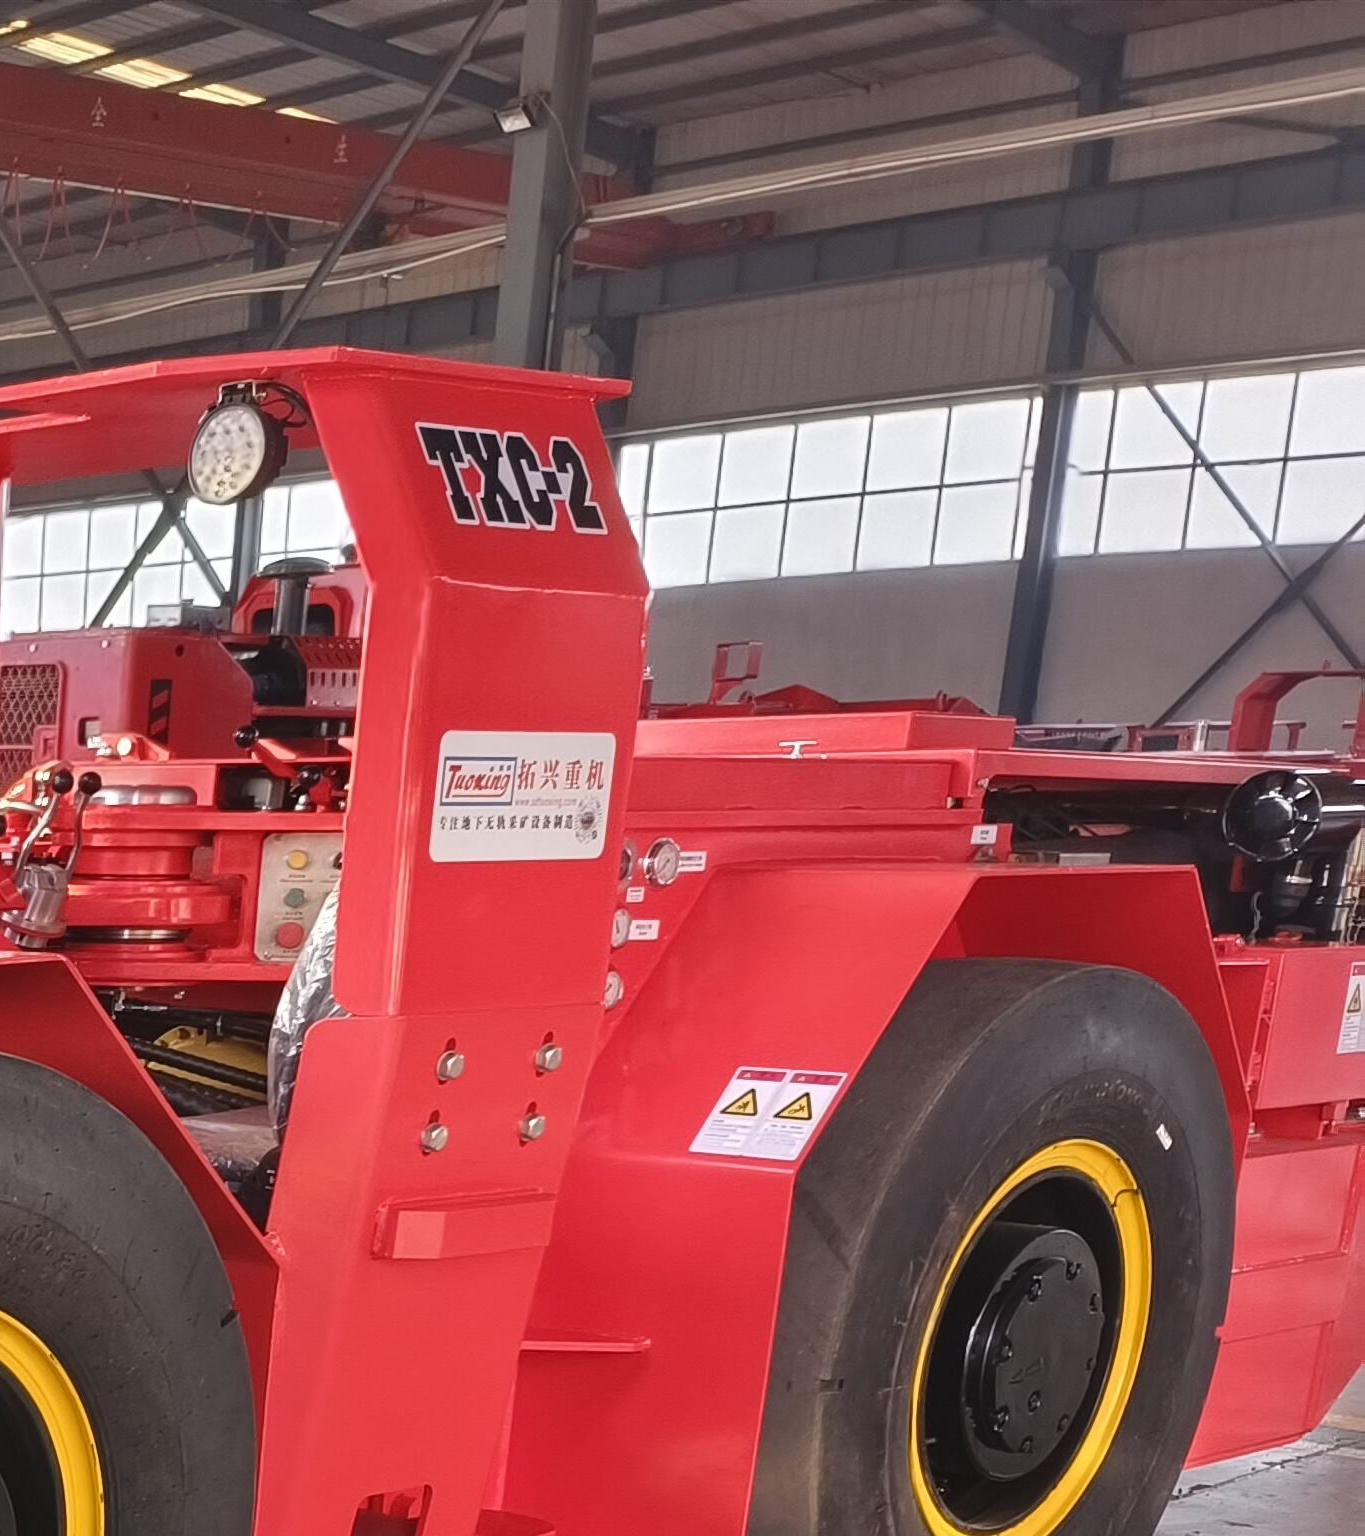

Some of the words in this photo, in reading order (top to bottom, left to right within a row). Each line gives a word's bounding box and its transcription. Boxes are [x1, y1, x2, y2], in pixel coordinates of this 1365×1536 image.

[416, 422, 609, 535] TXC-2
[445, 763, 512, 799] Tuoxing
[517, 759, 605, 790] 拓兴重机
